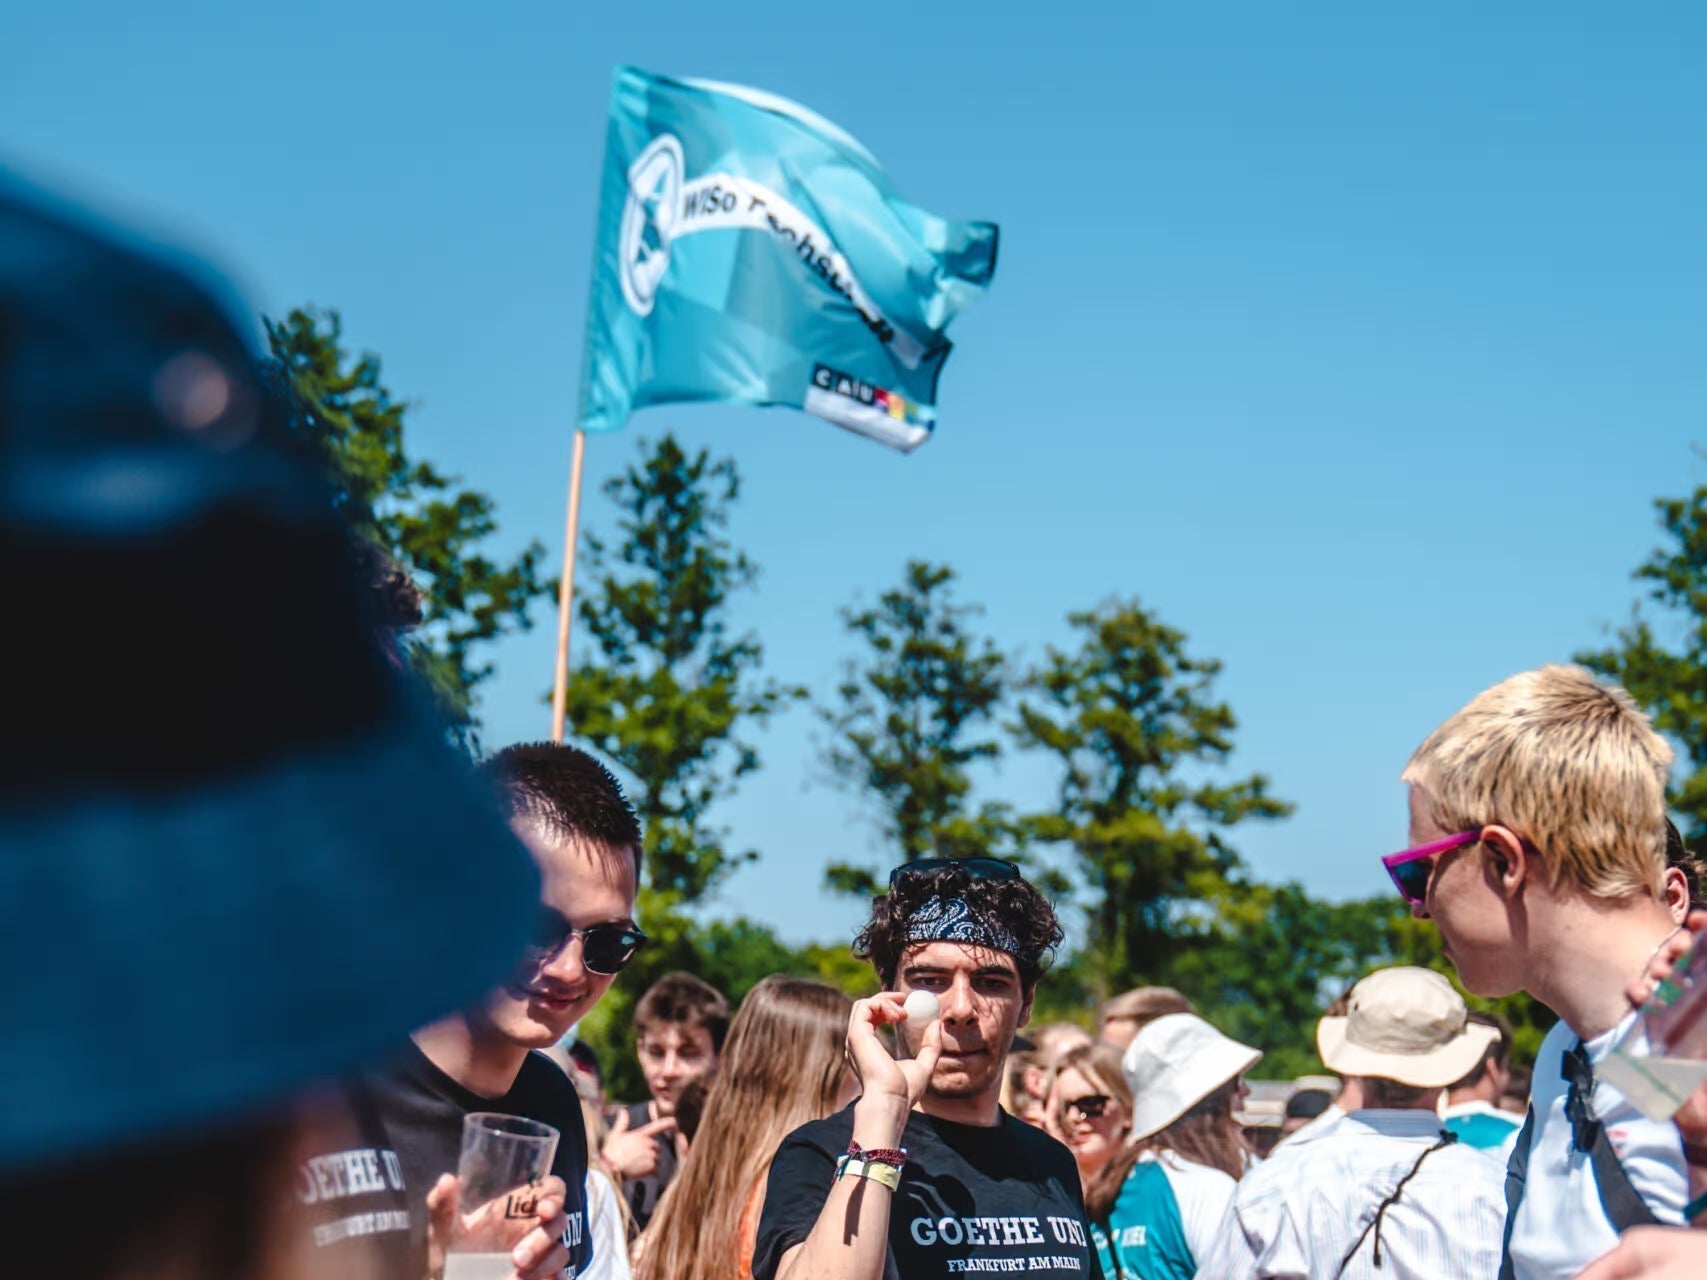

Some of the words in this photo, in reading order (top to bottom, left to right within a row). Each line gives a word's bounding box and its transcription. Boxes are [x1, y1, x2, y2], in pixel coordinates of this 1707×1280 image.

[910, 1217, 1045, 1246] GOETHE
[947, 1258, 1025, 1272] FRANKFURT
[1028, 1256, 1051, 1270] AM
[1051, 1256, 1081, 1270] MAIN
